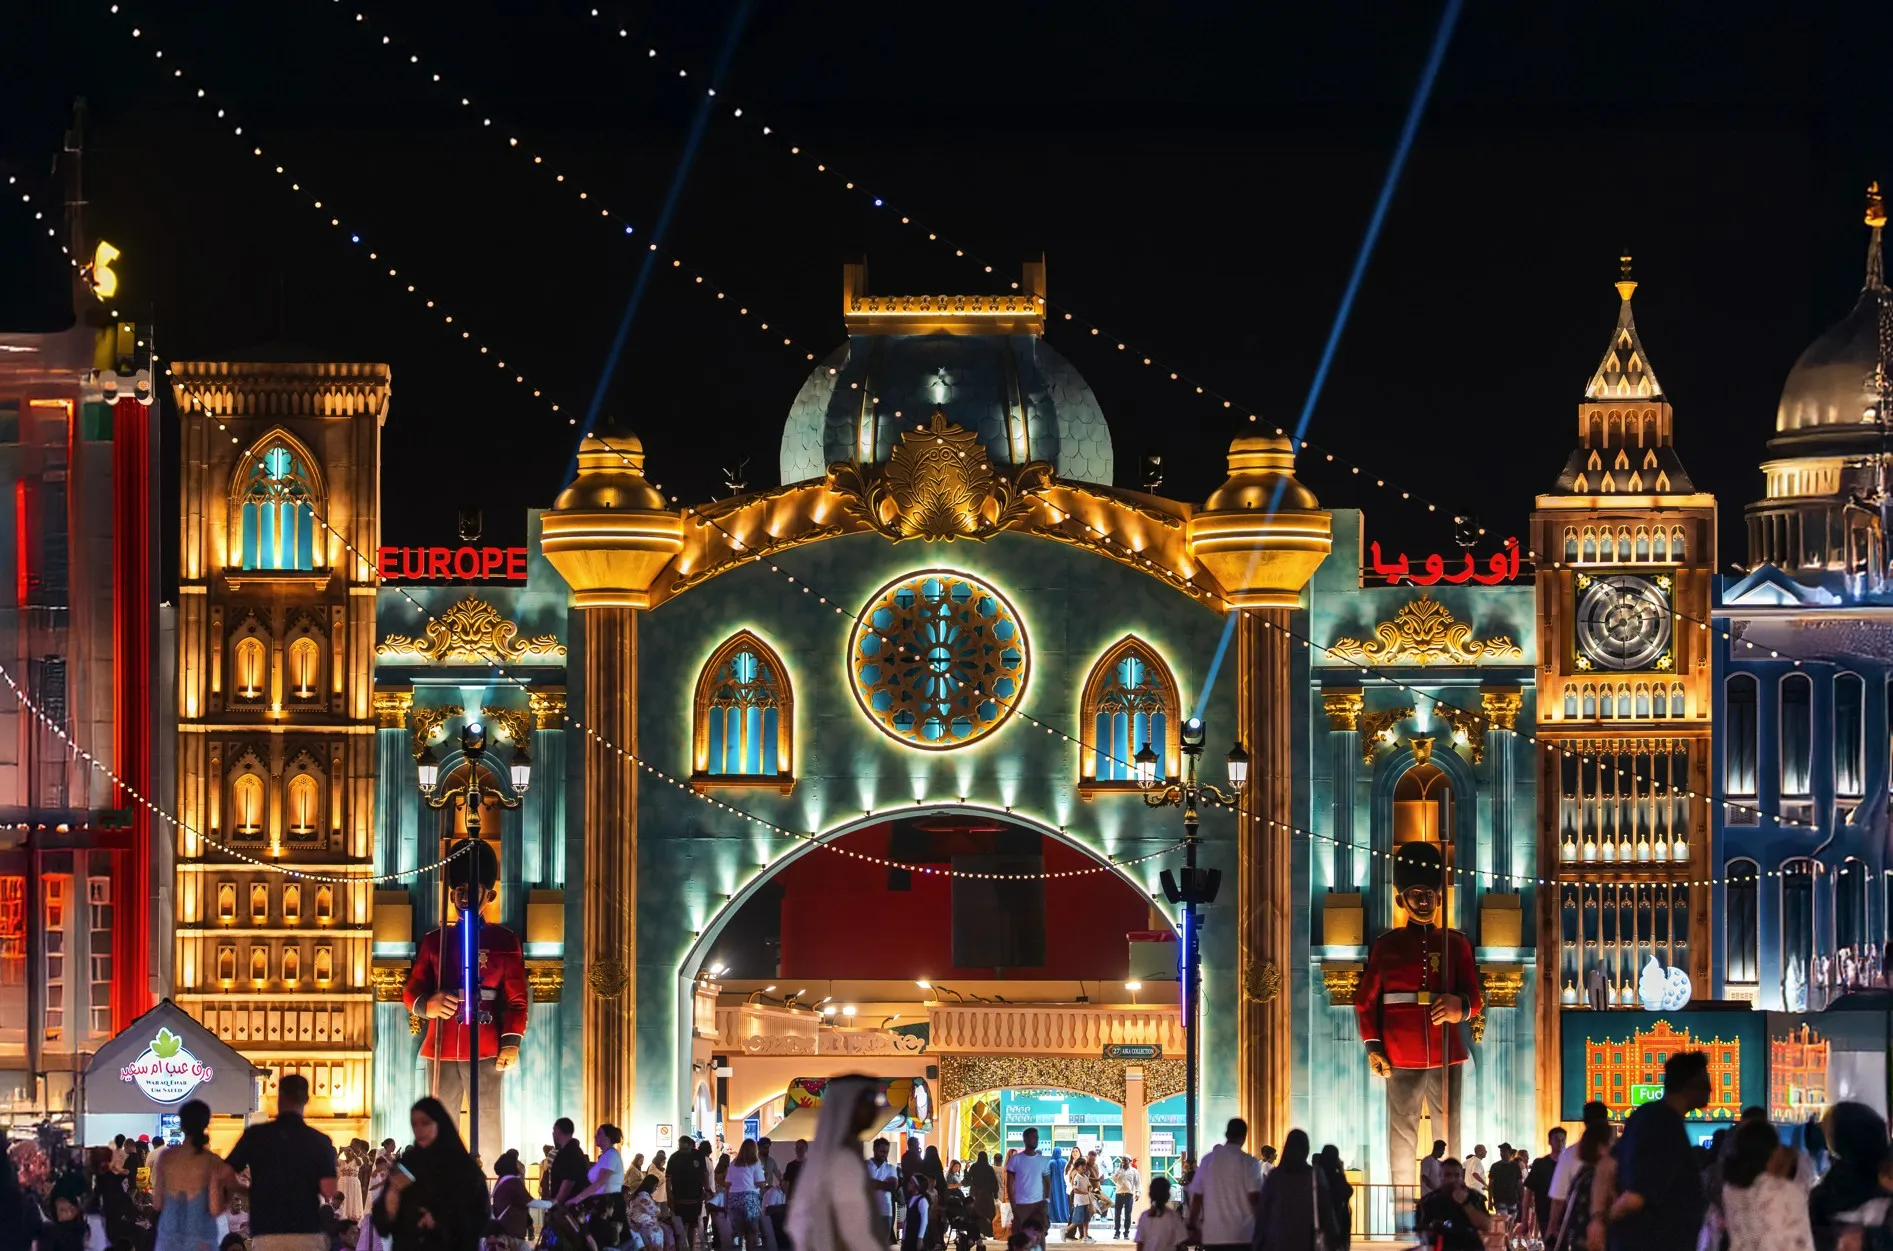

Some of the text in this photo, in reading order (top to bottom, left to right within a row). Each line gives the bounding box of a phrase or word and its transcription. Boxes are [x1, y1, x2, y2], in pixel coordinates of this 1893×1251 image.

[378, 547, 528, 579] EUROPE
[1371, 536, 1520, 585] أوروبا
[120, 1062, 148, 1081] سعيد
[191, 1060, 213, 1081] ورق
